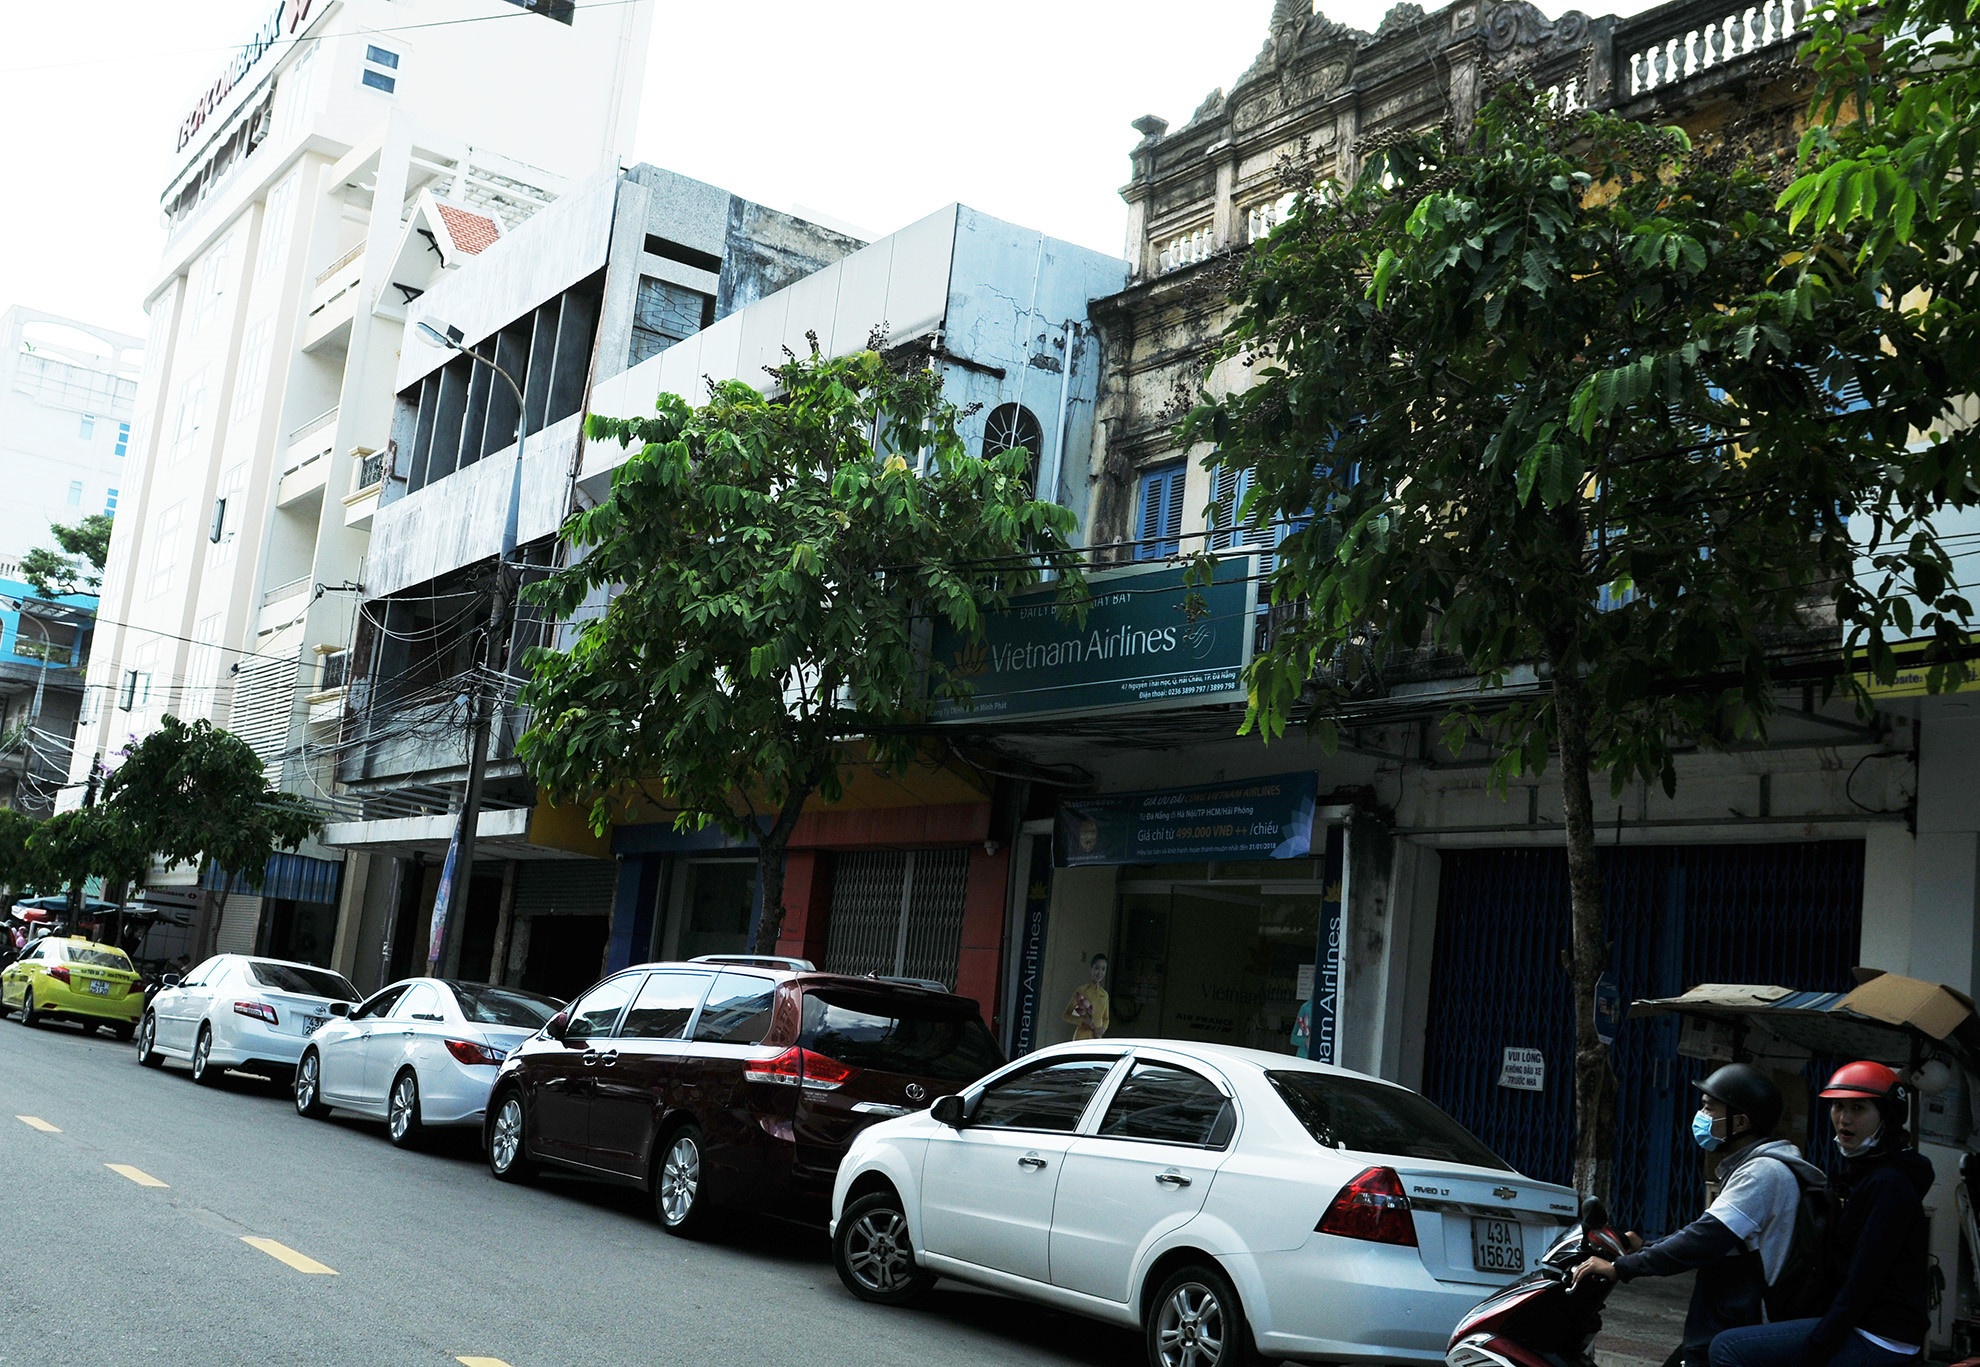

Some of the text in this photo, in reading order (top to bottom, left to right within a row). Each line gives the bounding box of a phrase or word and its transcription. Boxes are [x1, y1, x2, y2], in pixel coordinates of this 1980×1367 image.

[1112, 592, 1132, 605] BAY
[992, 625, 1176, 672] Vietnam Airlines
[1242, 784, 1281, 799] AIRLINES
[1176, 825, 1212, 840] 499.000
[1213, 823, 1234, 838] VNĐ
[1319, 916, 1341, 1014] Airlines
[1017, 911, 1043, 1059] etnam Airlines
[1508, 1051, 1521, 1062] VUI
[1413, 1185, 1450, 1197] AVEO LT
[1487, 1221, 1512, 1245] 43A
[1480, 1244, 1522, 1269] 156.29
